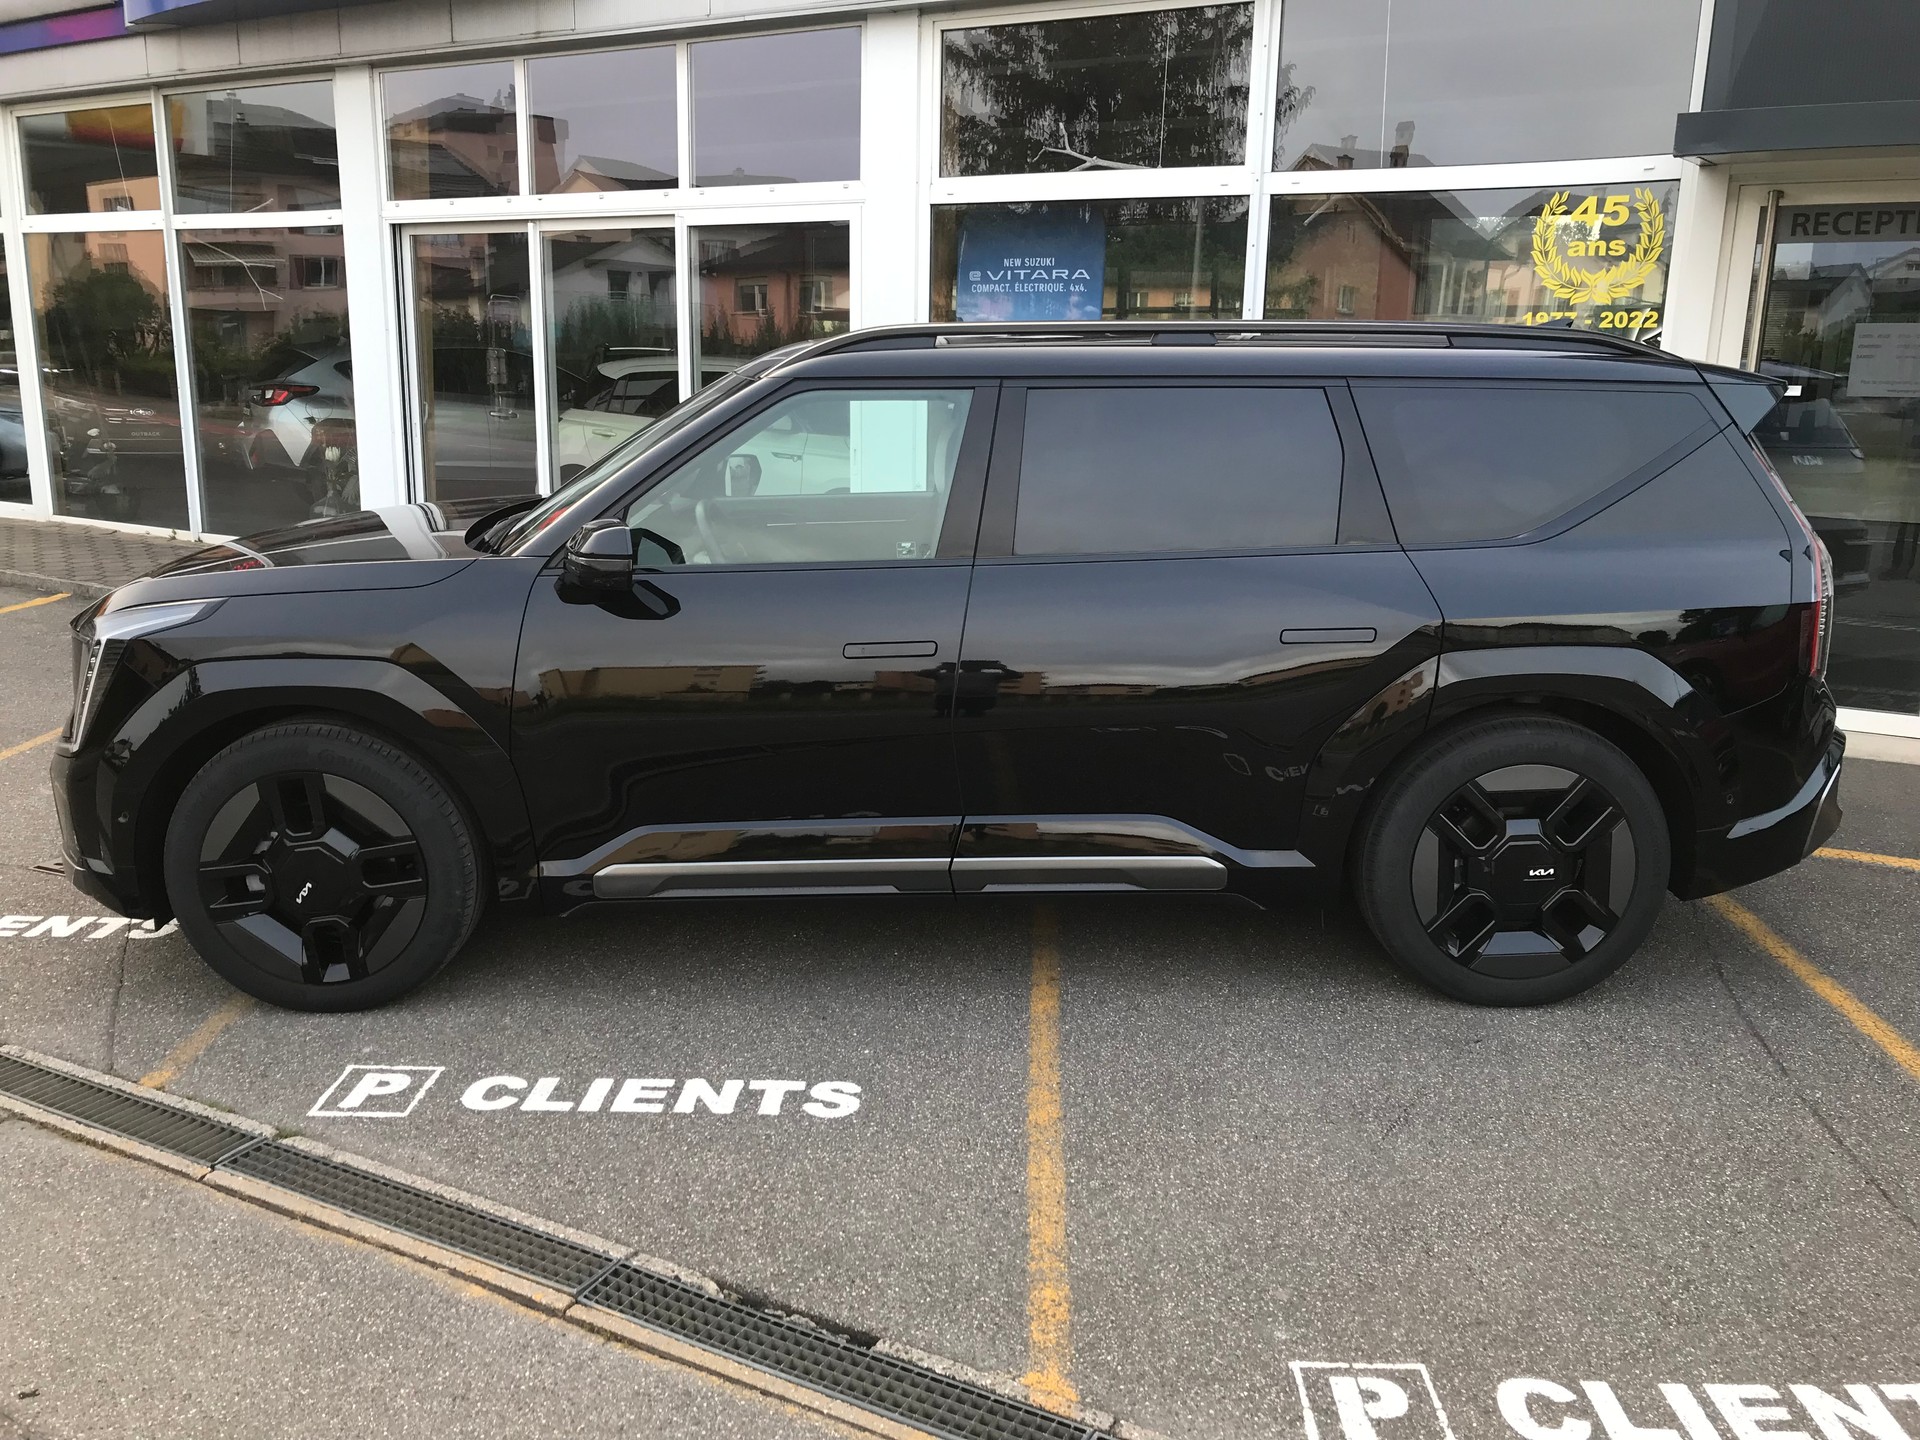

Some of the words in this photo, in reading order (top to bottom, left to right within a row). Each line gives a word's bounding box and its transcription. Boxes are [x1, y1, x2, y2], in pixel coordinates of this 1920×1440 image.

[1570, 195, 1631, 227] 45
[1567, 239, 1626, 257] ans
[1003, 258, 1022, 267] NEW
[1024, 257, 1055, 267] SUZUKI
[986, 269, 1091, 281] VITARA
[971, 284, 1012, 293] COMPACT.
[1014, 282, 1067, 292] ÉLECTRIQUE.
[1069, 283, 1087, 292] 4x4.
[1598, 311, 1659, 329] 2022
[337, 1072, 412, 1109] P
[460, 1075, 862, 1118] CLIENTS
[1328, 1376, 1409, 1440] P
